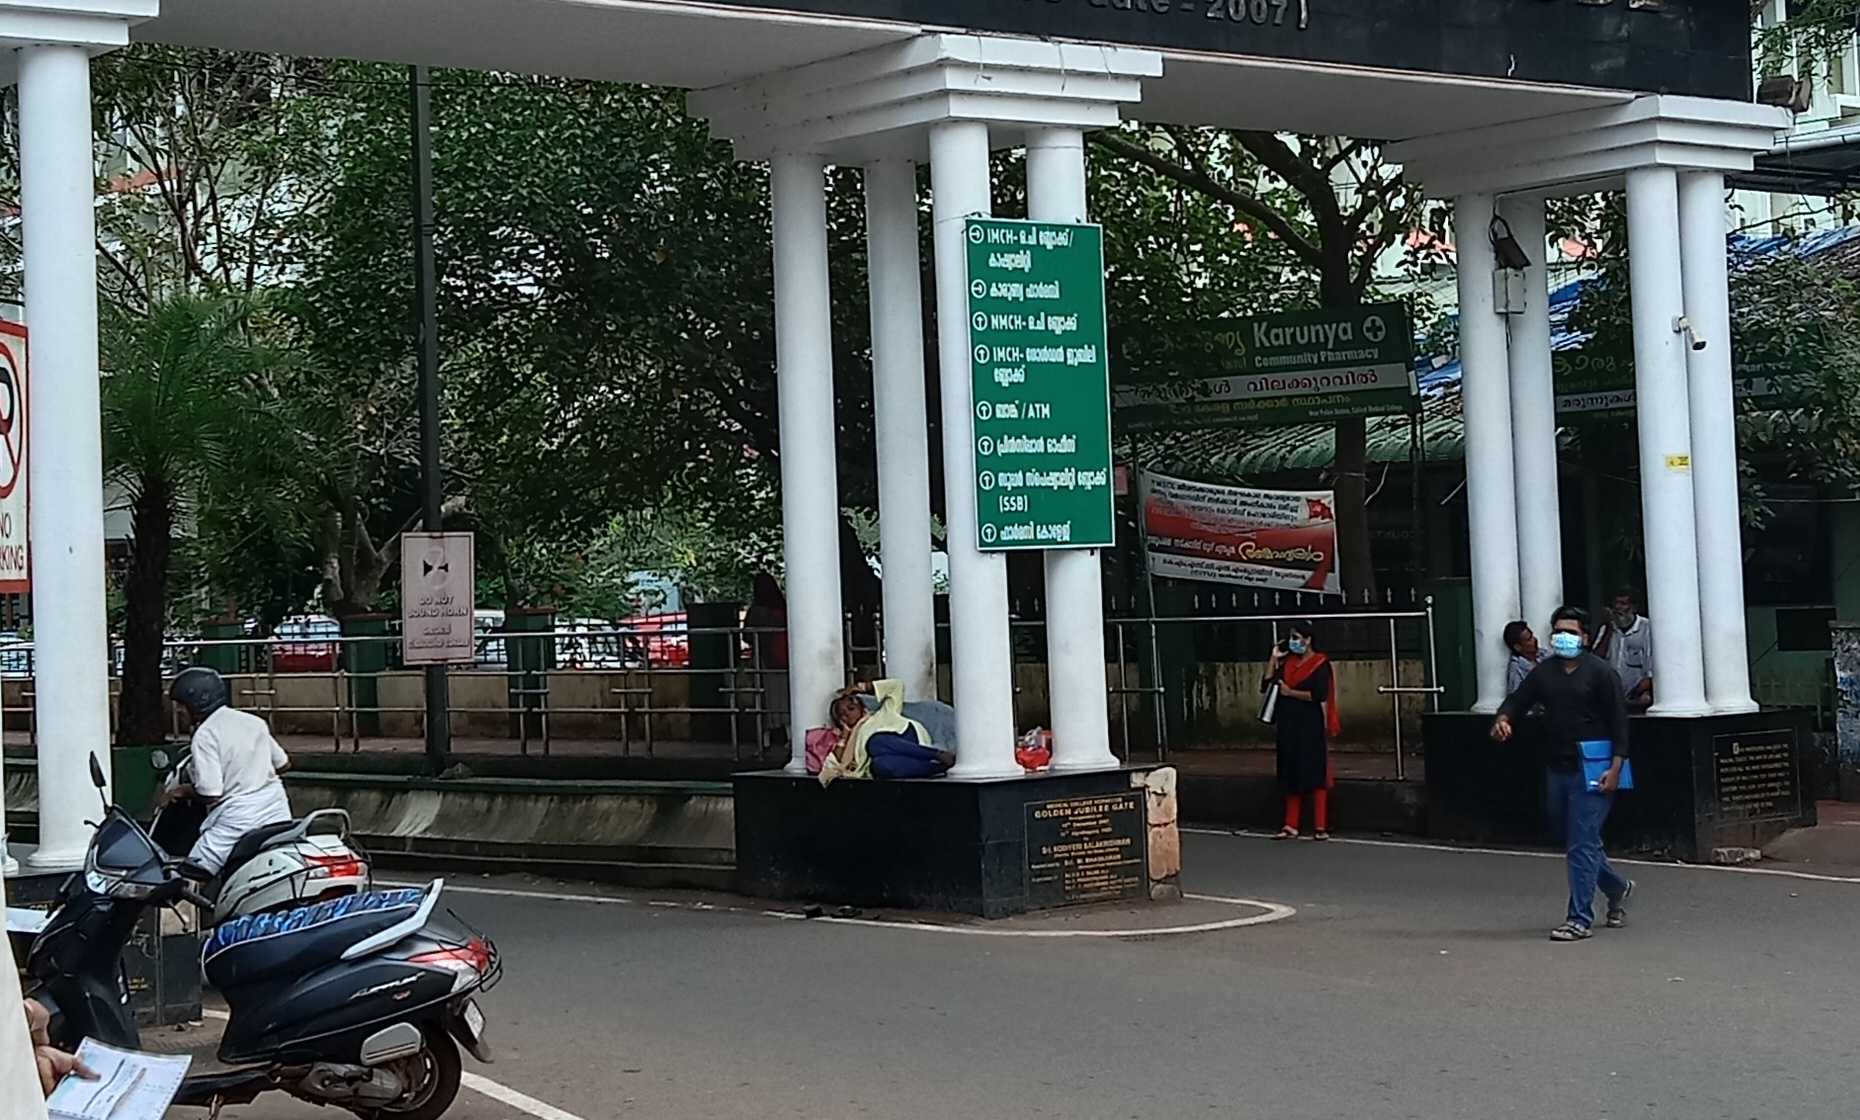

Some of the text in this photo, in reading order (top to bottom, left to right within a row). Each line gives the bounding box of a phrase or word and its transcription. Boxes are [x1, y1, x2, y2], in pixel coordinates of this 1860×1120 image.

[987, 228, 1018, 244] IMCH-
[990, 314, 1026, 330] NMCH-
[1252, 320, 1353, 349] Karunya
[992, 346, 1024, 362] IMCH-
[1254, 352, 1318, 368] Community
[1320, 347, 1379, 363] Pharmacy
[1247, 369, 1378, 392] വിലക്കുറവിൽ
[1027, 403, 1051, 419] ATM
[999, 495, 1028, 513] (SSB)
[1034, 808, 1072, 819] GOLDEN
[1073, 804, 1110, 815] JUBILEE
[1111, 801, 1135, 811] GATE
